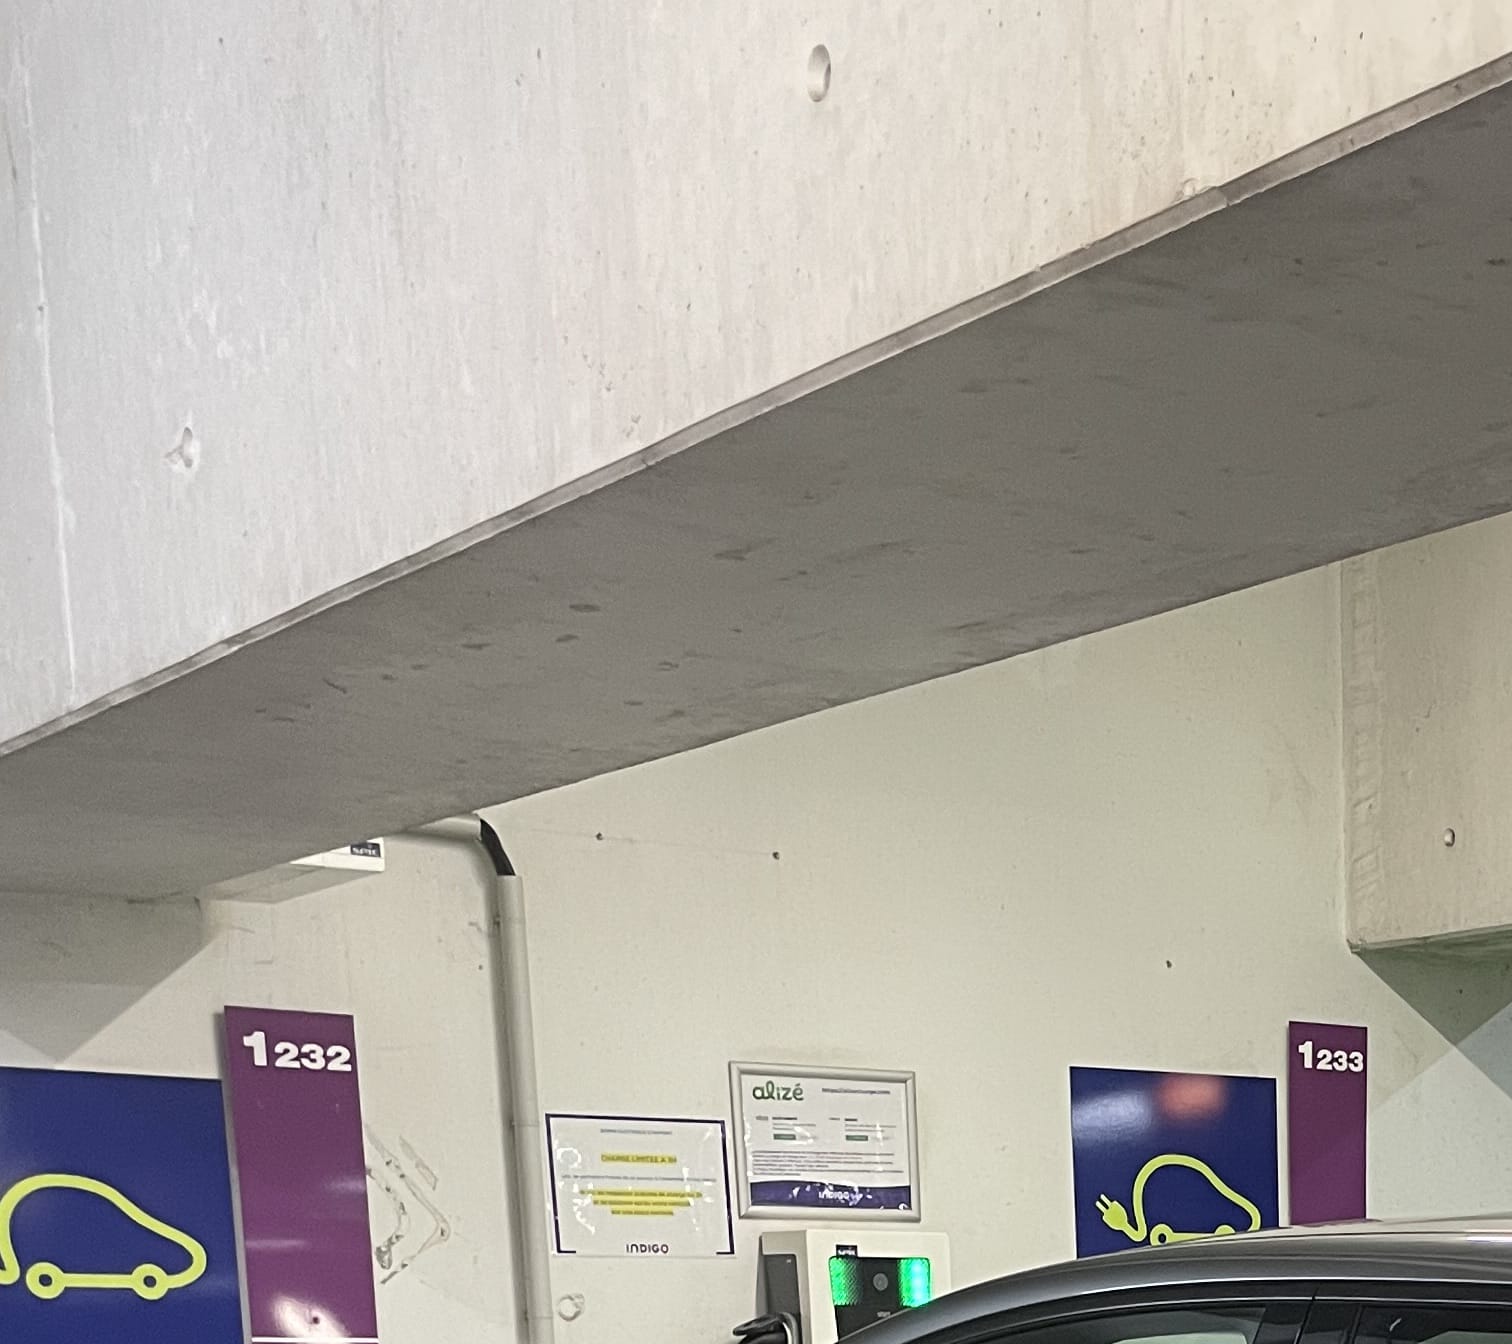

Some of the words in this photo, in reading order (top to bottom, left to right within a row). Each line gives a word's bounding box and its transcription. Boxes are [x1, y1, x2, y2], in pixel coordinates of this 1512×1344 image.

[242, 1030, 352, 1072] 1232
[1297, 1041, 1365, 1073] 1233
[752, 1080, 805, 1102] alizé
[626, 1243, 669, 1254] INDIGO
